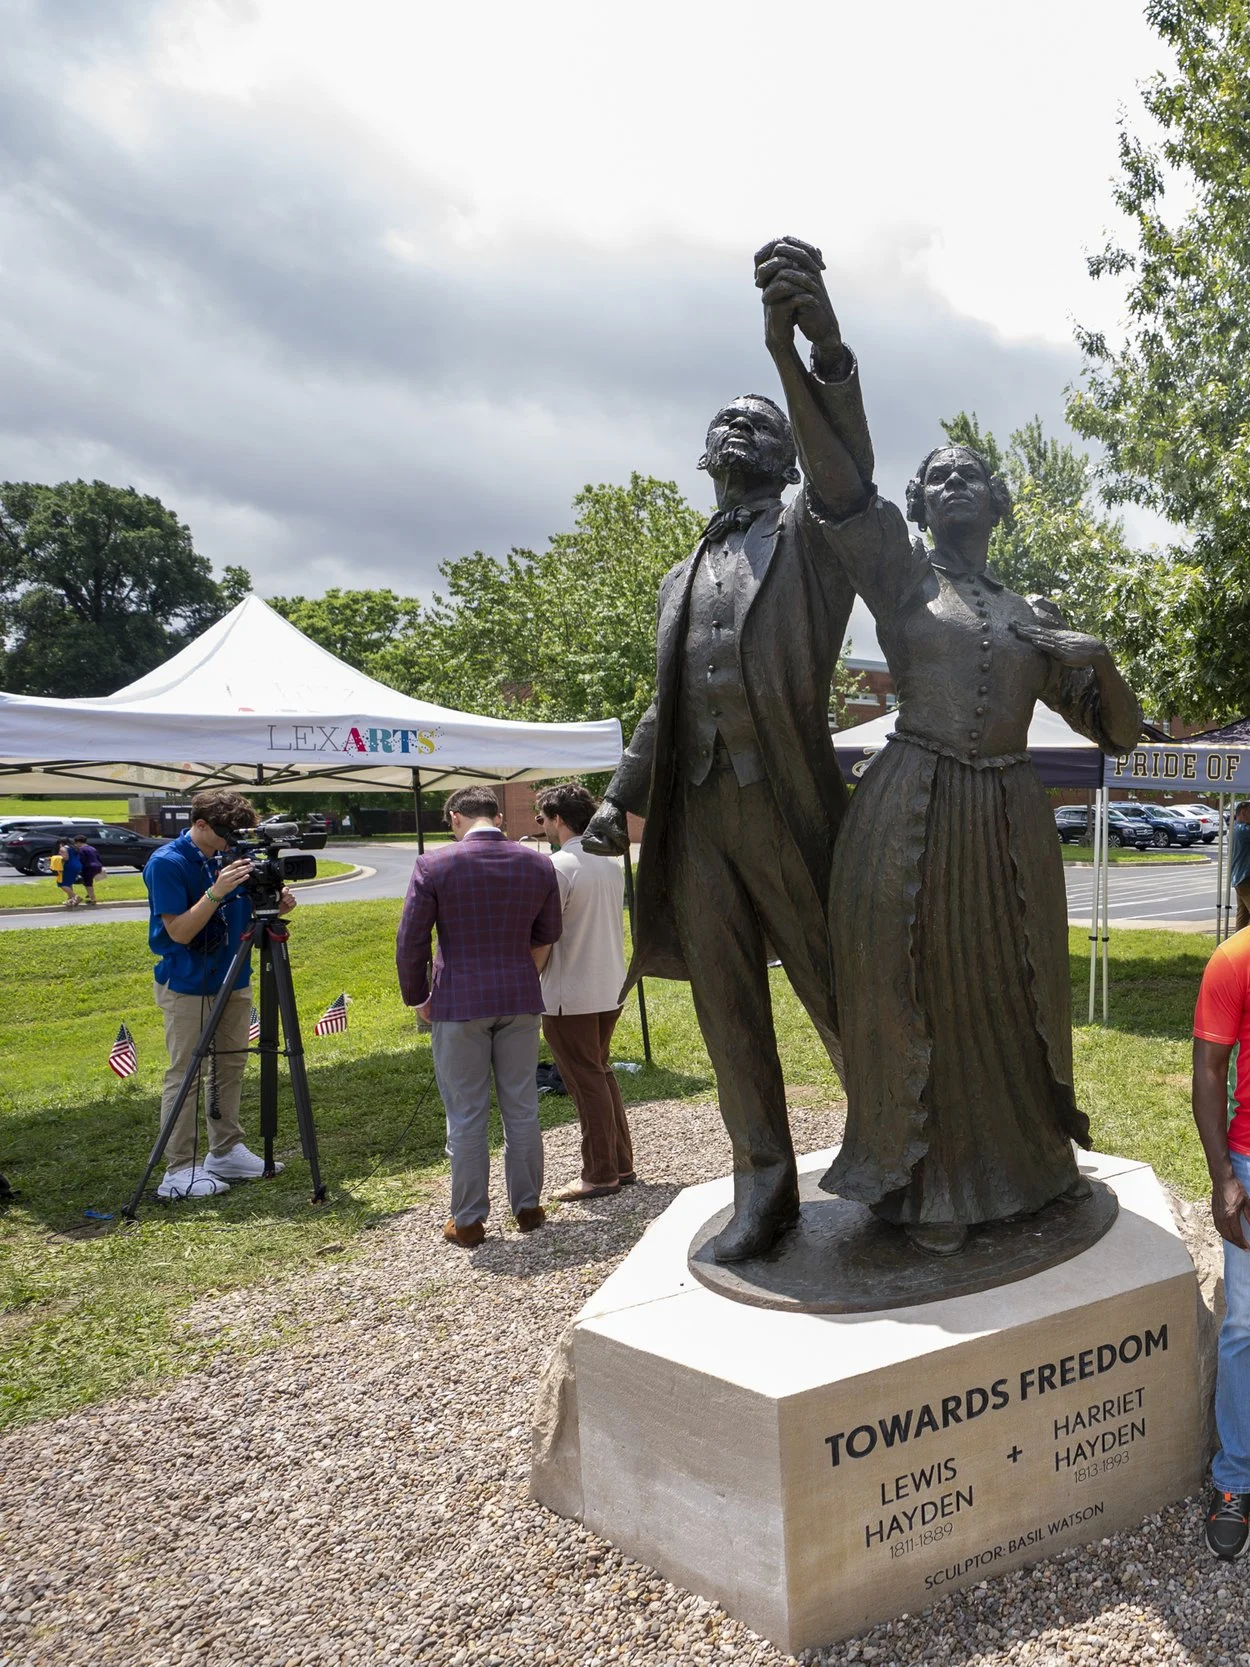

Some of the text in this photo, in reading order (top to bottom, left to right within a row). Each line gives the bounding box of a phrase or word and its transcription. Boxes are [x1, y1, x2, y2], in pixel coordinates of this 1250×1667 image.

[266, 724, 438, 755] LEXARTS
[1114, 750, 1198, 781] PRIDE
[1206, 753, 1241, 782] OF
[824, 1324, 1169, 1467] TOWARDS FREEDOM
[1053, 1386, 1146, 1441] HARRIET
[1055, 1417, 1146, 1473] HAYDEN
[1073, 1450, 1130, 1484] 1813-1893
[880, 1457, 958, 1506] LEWIS
[865, 1485, 974, 1548] HAYDEN
[889, 1522, 954, 1560] 1811-1889
[924, 1501, 1105, 1591] SCULPTOR: BASIL WATSON
